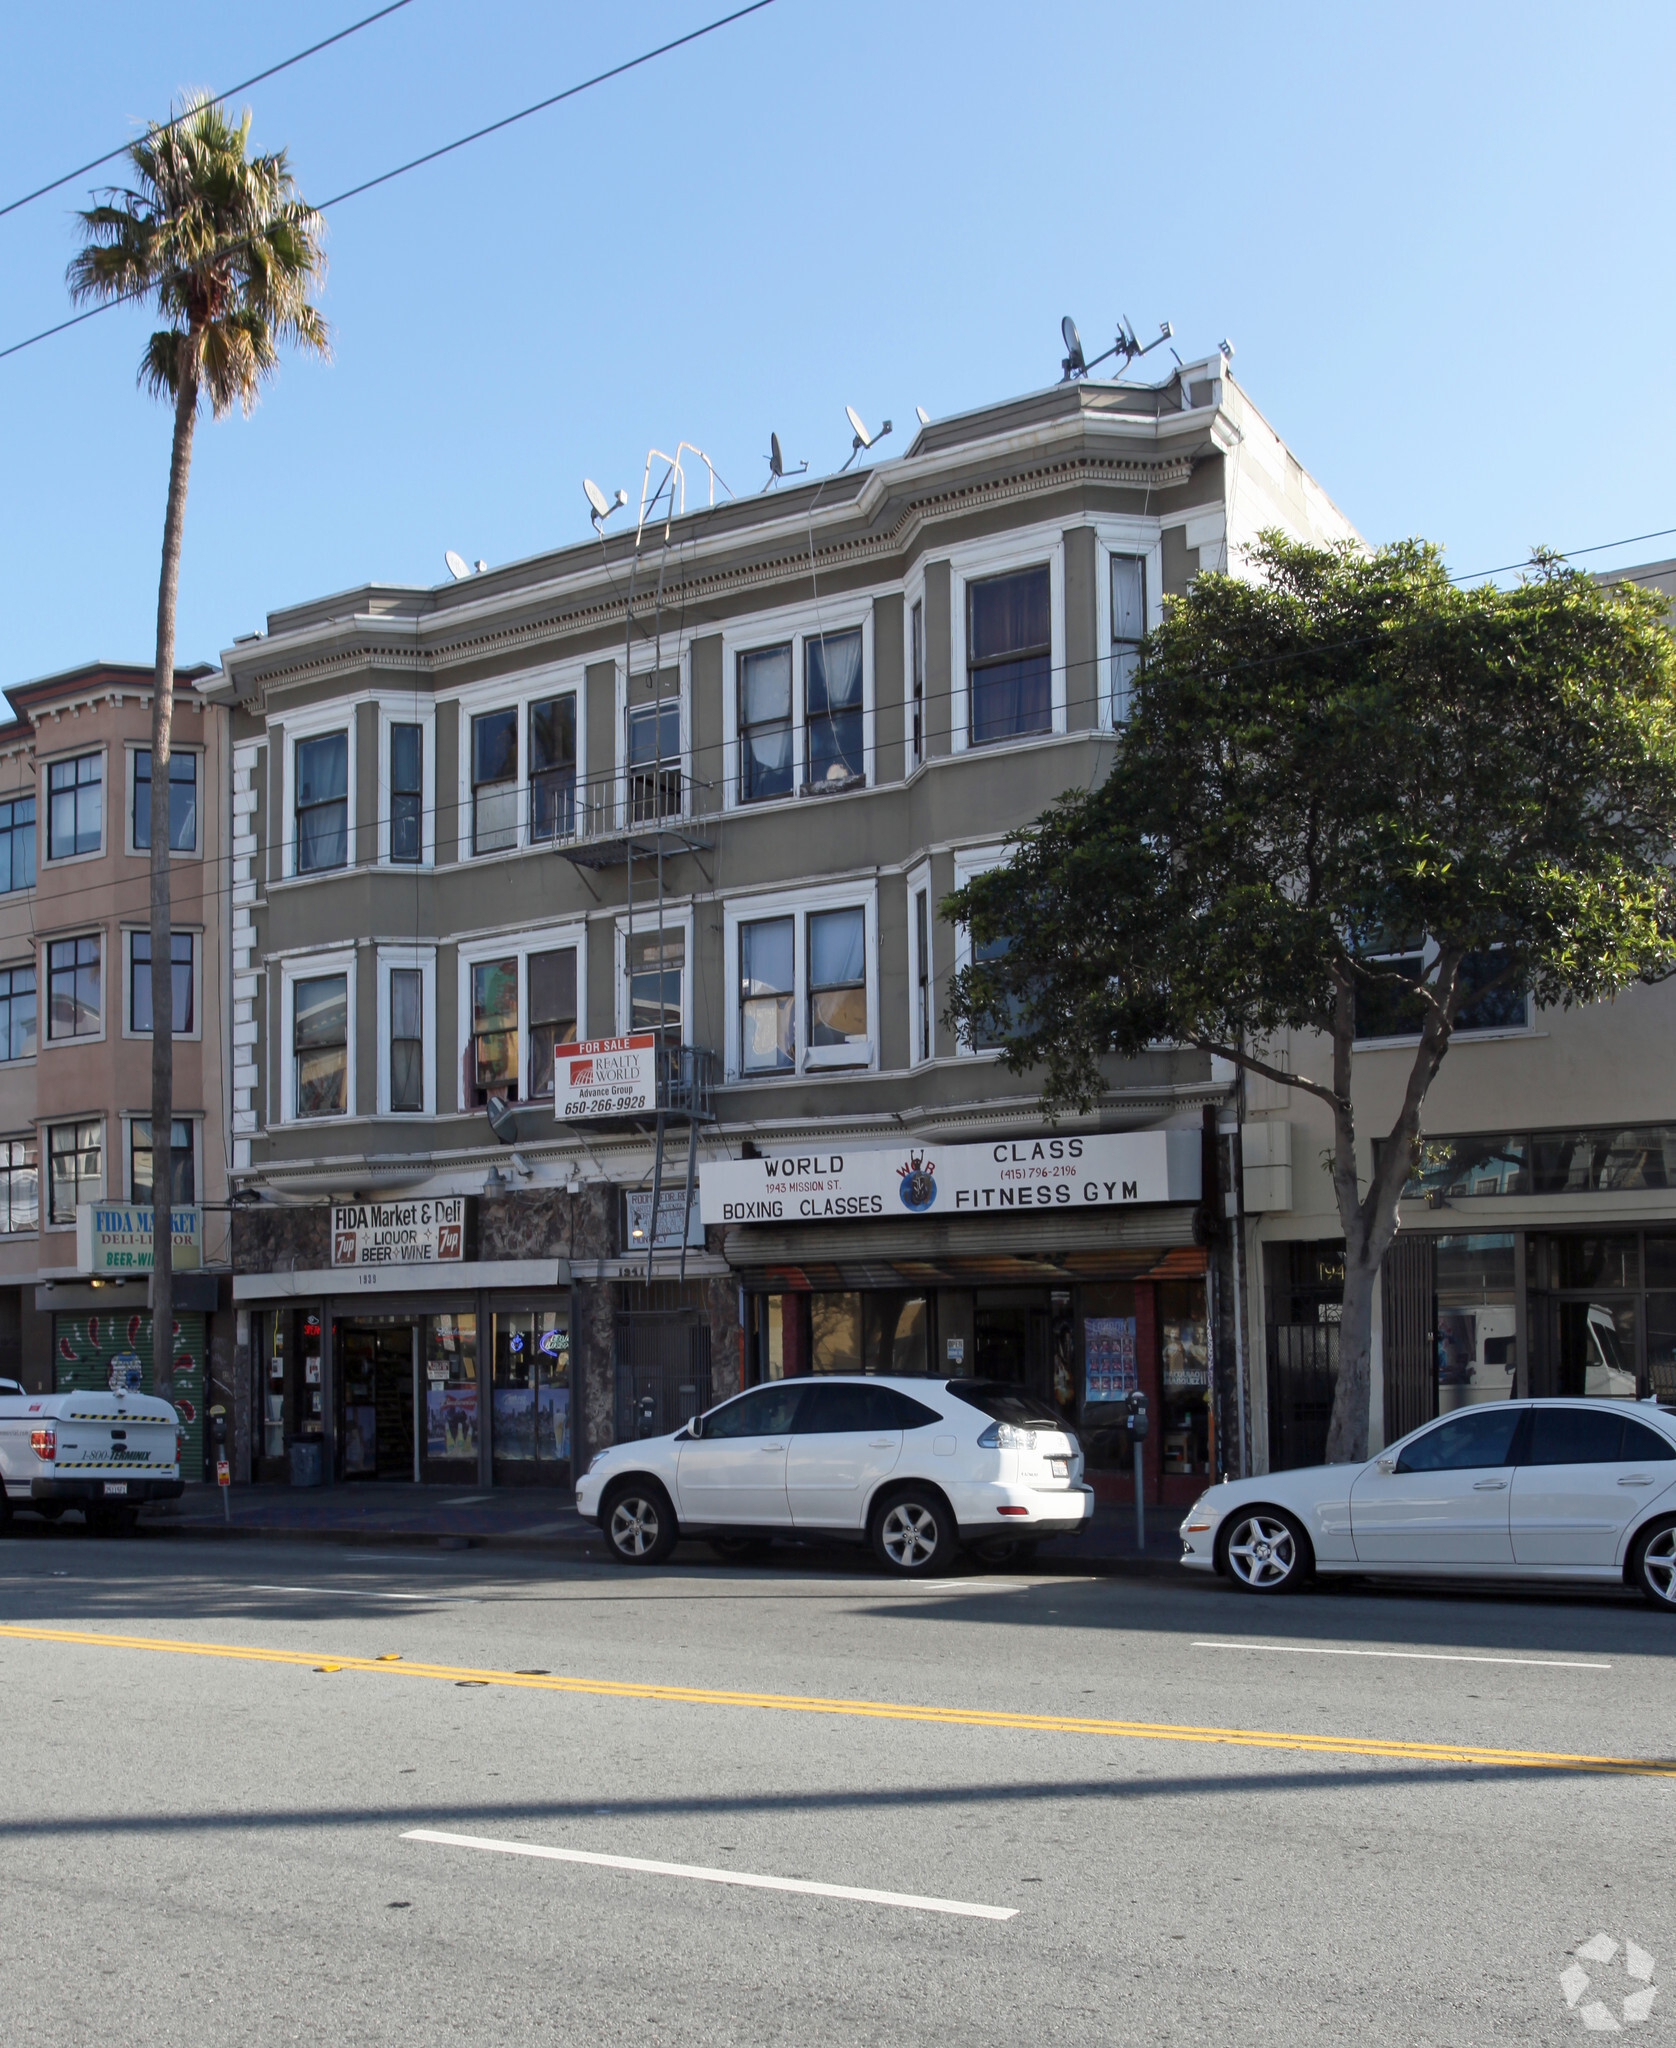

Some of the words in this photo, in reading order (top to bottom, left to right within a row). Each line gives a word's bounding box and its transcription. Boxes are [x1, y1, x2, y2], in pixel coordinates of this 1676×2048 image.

[579, 1042, 600, 1054] FOR
[604, 1039, 630, 1052] SALE
[596, 1054, 640, 1070] REALTY
[596, 1067, 640, 1082] WORLD
[579, 1089, 609, 1098] Advance
[611, 1086, 633, 1095] Group
[565, 1096, 646, 1115] 650-266-9928
[993, 1139, 1084, 1163] CLASS
[765, 1156, 844, 1177] WORLD
[1000, 1168, 1026, 1180] (415)
[1029, 1166, 1077, 1178] 796-2196
[766, 1182, 787, 1193] 1943
[789, 1181, 824, 1192] MISSION
[828, 1180, 842, 1190] ST.
[956, 1184, 1071, 1208] FITNESS
[1083, 1181, 1138, 1201] GYM
[335, 1206, 369, 1230] FIDA
[371, 1204, 417, 1228] Market
[421, 1203, 432, 1224] &
[435, 1200, 461, 1223] Deli
[723, 1201, 783, 1220] BOXING
[800, 1195, 883, 1216] CLASSES
[96, 1211, 133, 1233] FIDA
[136, 1212, 197, 1233] MAKET
[374, 1230, 417, 1245] LIQUOR
[361, 1247, 392, 1262] BEER
[401, 1245, 431, 1260] WINE
[81, 1451, 151, 1461] 1-800-TERMINIX
